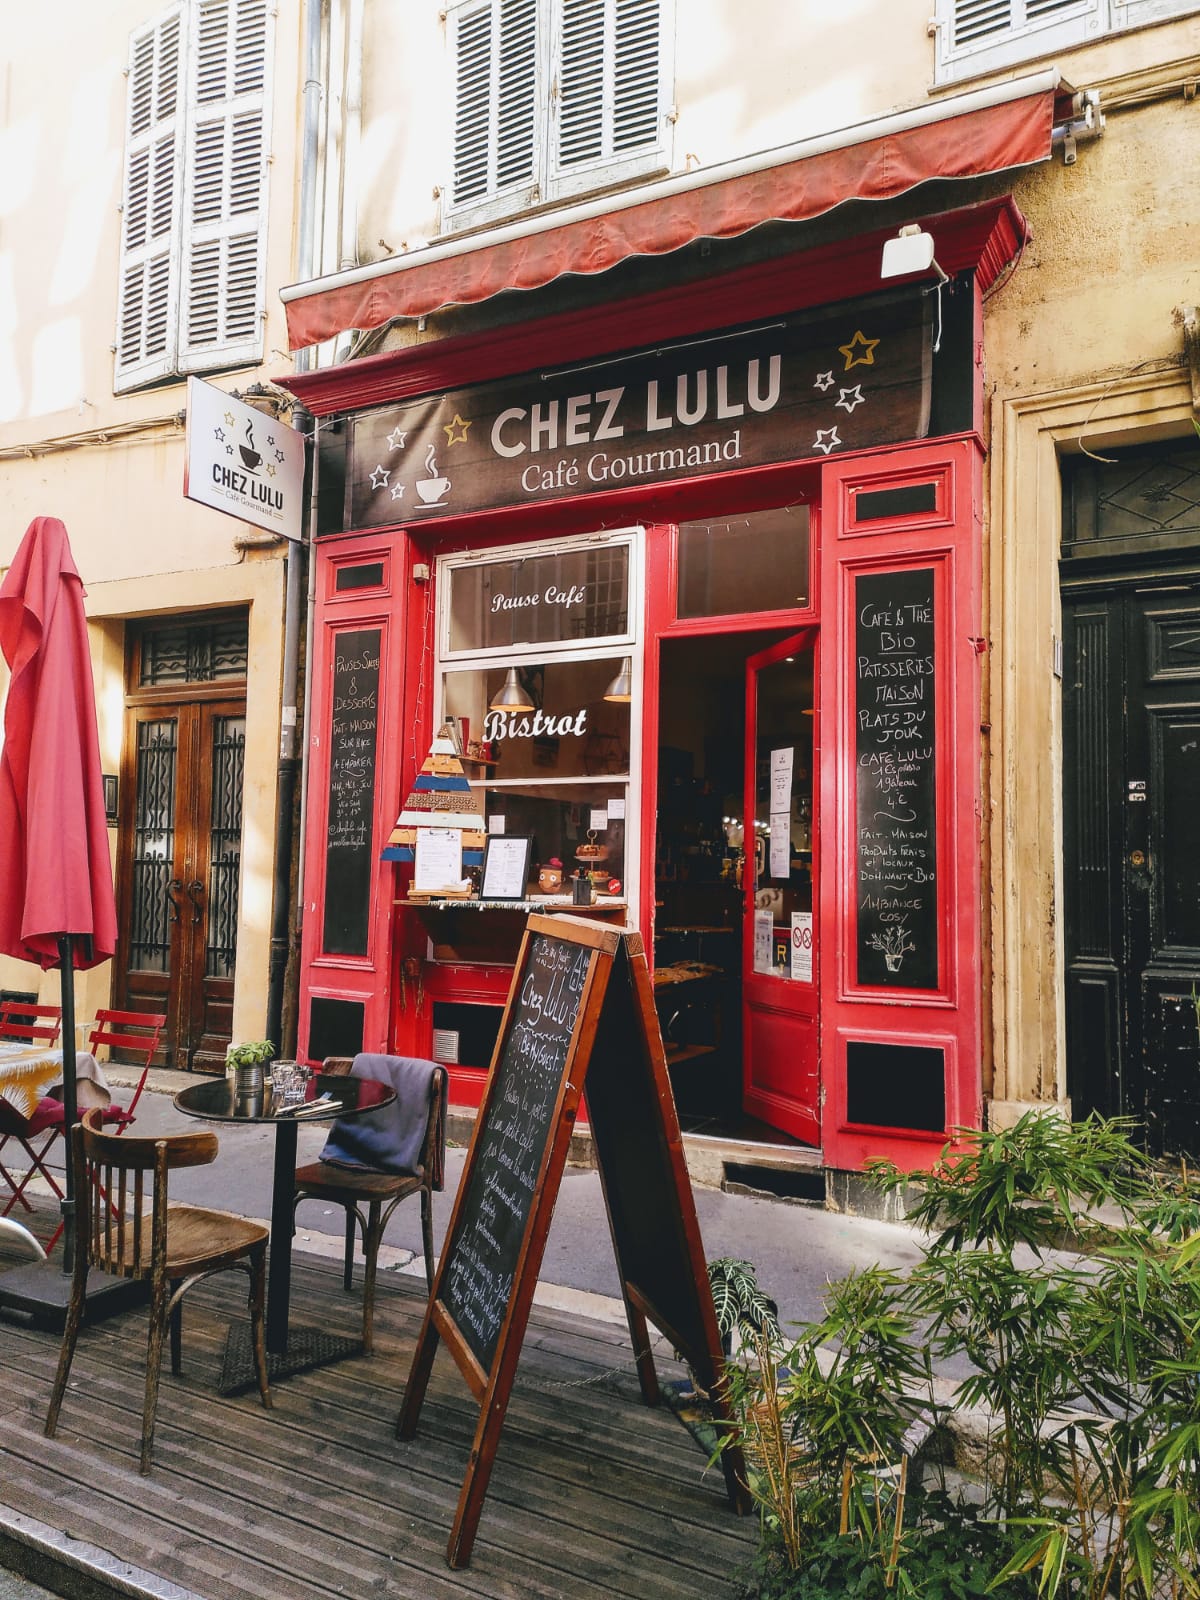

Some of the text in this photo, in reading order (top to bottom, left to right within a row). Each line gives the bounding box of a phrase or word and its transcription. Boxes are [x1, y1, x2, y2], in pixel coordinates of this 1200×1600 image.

[490, 354, 783, 458] CHEZ LULU
[521, 430, 743, 494] Café Gourmand
[212, 463, 284, 511] CHEZ LULU
[225, 490, 273, 517] Café Gourmand
[491, 585, 587, 613] Pause Café
[334, 691, 376, 711] DESSERTS
[481, 709, 587, 743] Bistrot
[858, 709, 926, 731] PLATS DU
[876, 726, 923, 743] JOUR
[898, 746, 932, 762] LULU
